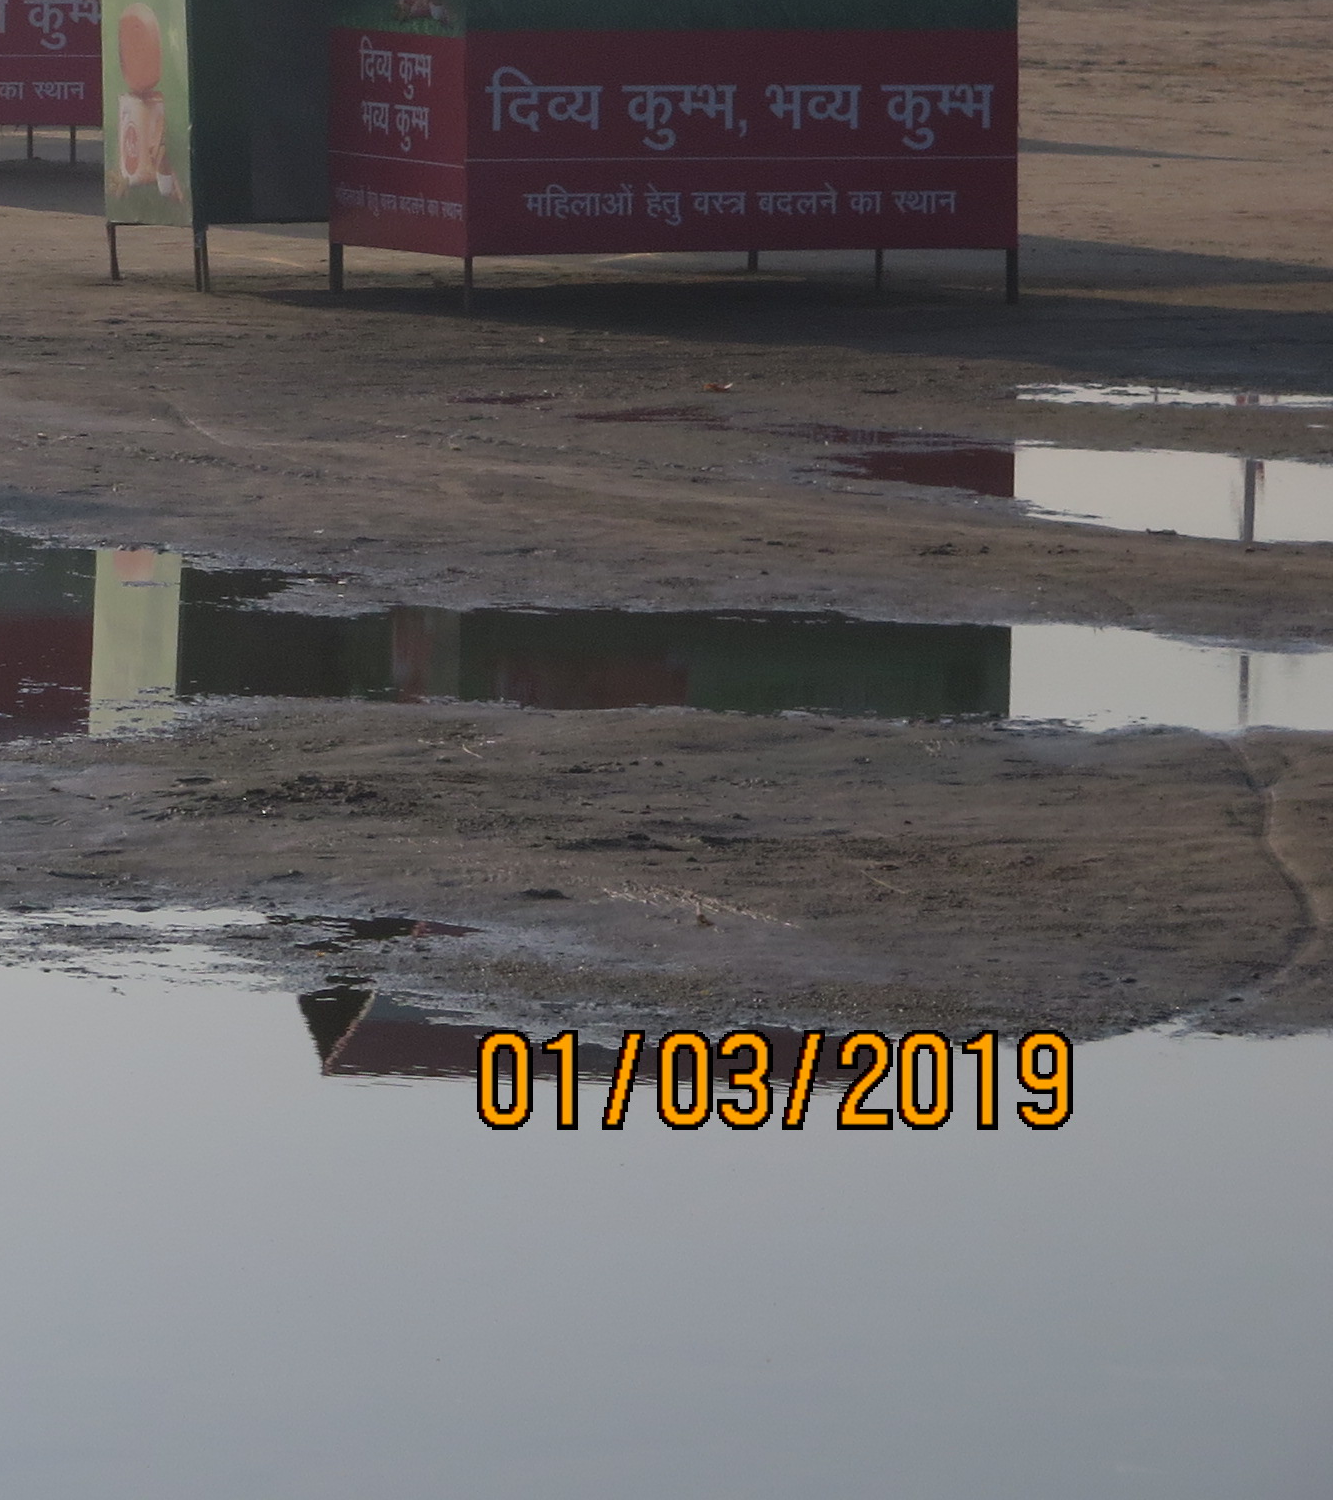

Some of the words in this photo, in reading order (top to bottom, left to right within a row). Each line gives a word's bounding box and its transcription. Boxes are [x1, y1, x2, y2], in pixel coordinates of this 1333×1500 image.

[33, 81, 85, 100] स्थान
[359, 36, 392, 82] दिव्य
[397, 52, 432, 100] कुम्भ
[361, 101, 389, 134] भव्य
[394, 104, 429, 152] कुम्भ
[485, 66, 603, 132] दिव्य
[621, 83, 748, 152] कुम्भ,
[765, 84, 862, 130] भव्य
[881, 83, 995, 151] कुम्भ
[523, 184, 633, 218] महिलाओं
[644, 184, 683, 225] हेतु
[691, 192, 747, 218] वस्त्र
[757, 182, 838, 216] बदलने
[848, 190, 882, 215] का
[892, 190, 957, 215] स्थान
